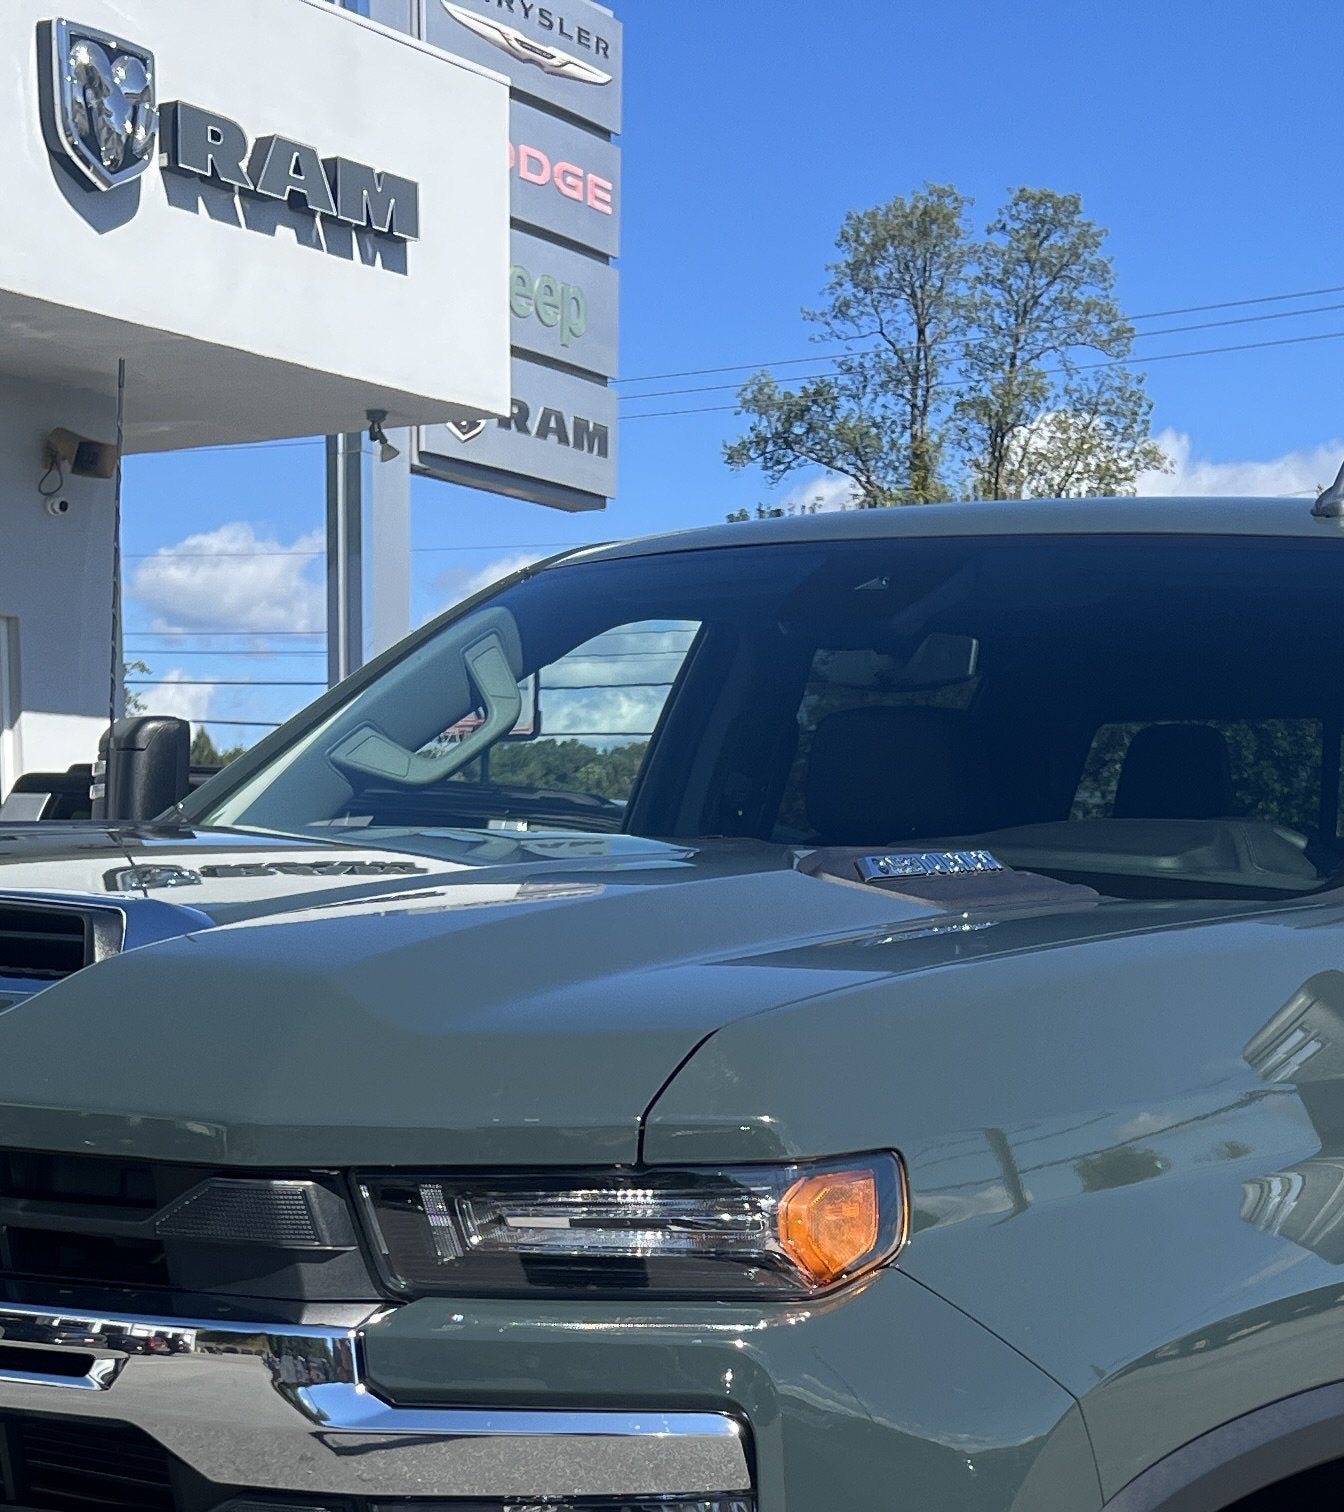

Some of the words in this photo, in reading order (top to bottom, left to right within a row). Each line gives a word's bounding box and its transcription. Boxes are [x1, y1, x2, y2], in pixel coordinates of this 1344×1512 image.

[484, 0, 610, 59] RYSLER
[160, 100, 421, 241] RAM
[509, 143, 613, 215] DGE
[497, 398, 609, 459] RAM
